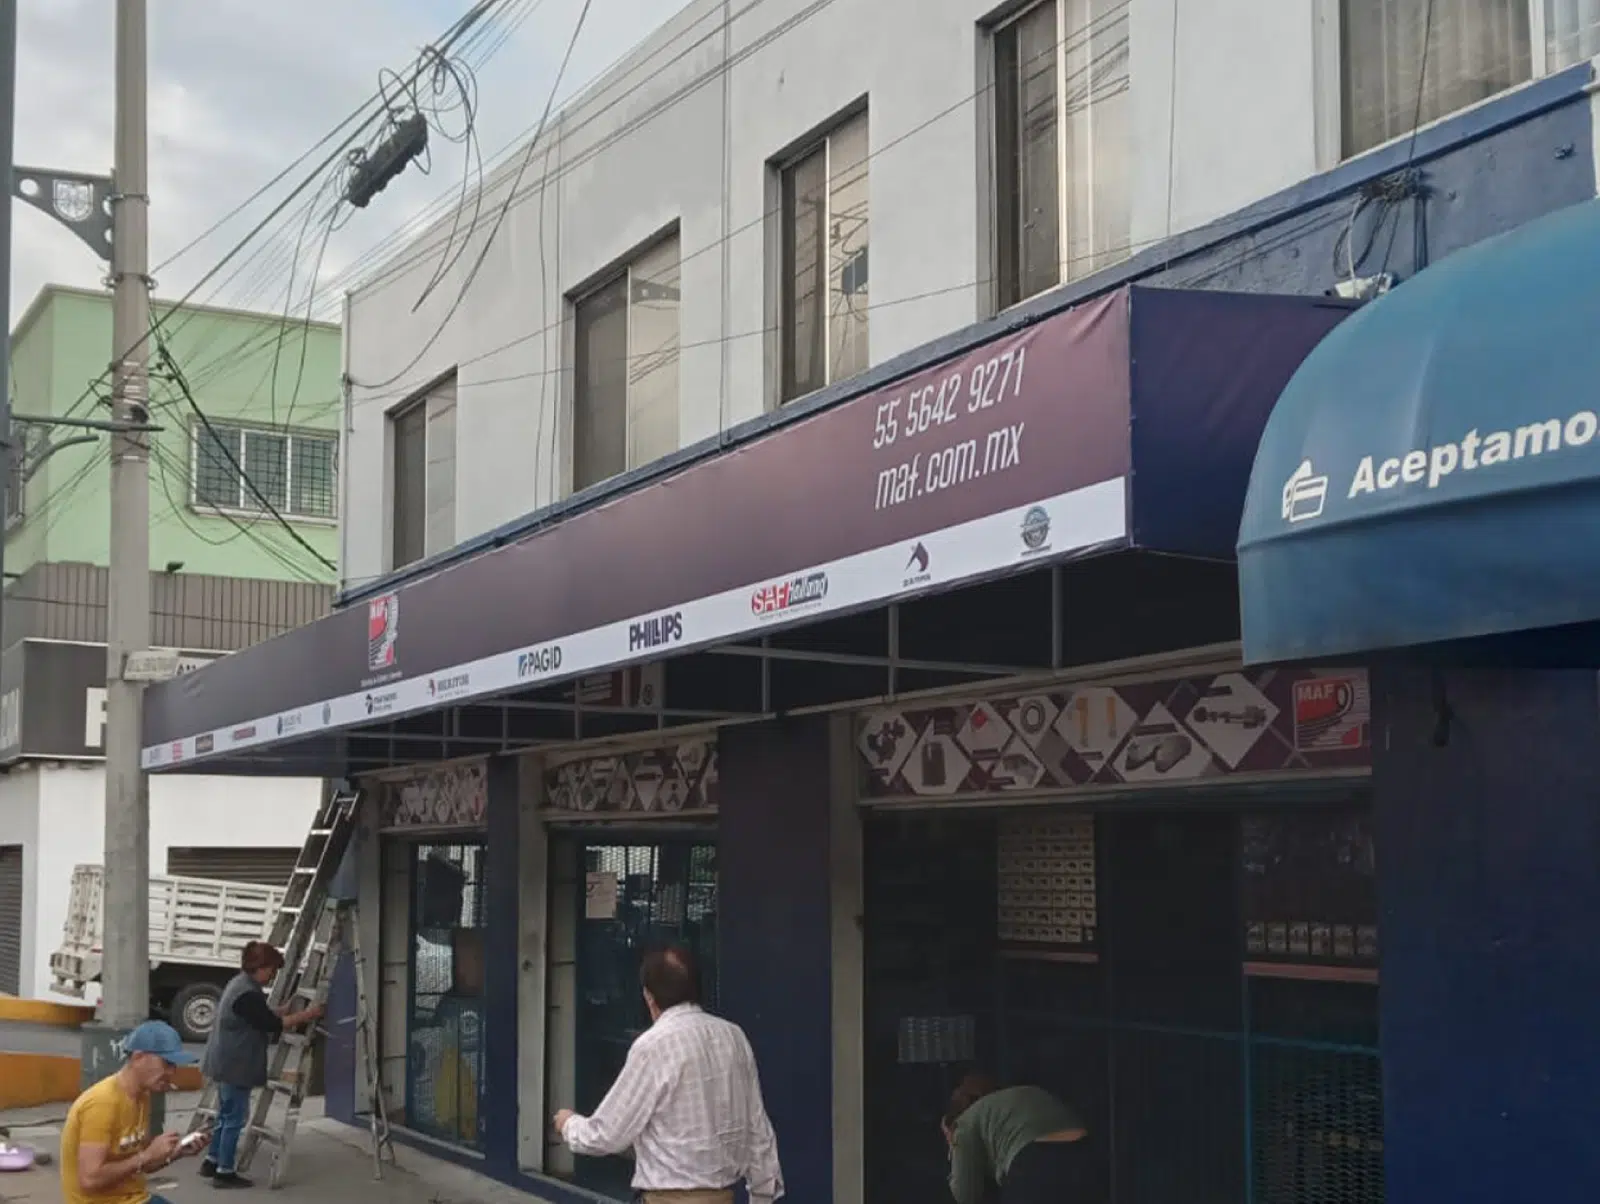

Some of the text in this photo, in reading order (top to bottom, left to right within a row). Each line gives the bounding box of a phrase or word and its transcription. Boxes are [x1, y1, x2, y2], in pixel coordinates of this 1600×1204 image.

[873, 347, 1026, 449] 55 5642 9271
[875, 422, 1025, 511] maf.com.mx
[1348, 410, 1600, 499] Aceptamo
[528, 645, 562, 676] PAGID
[1297, 683, 1335, 701] MAF
